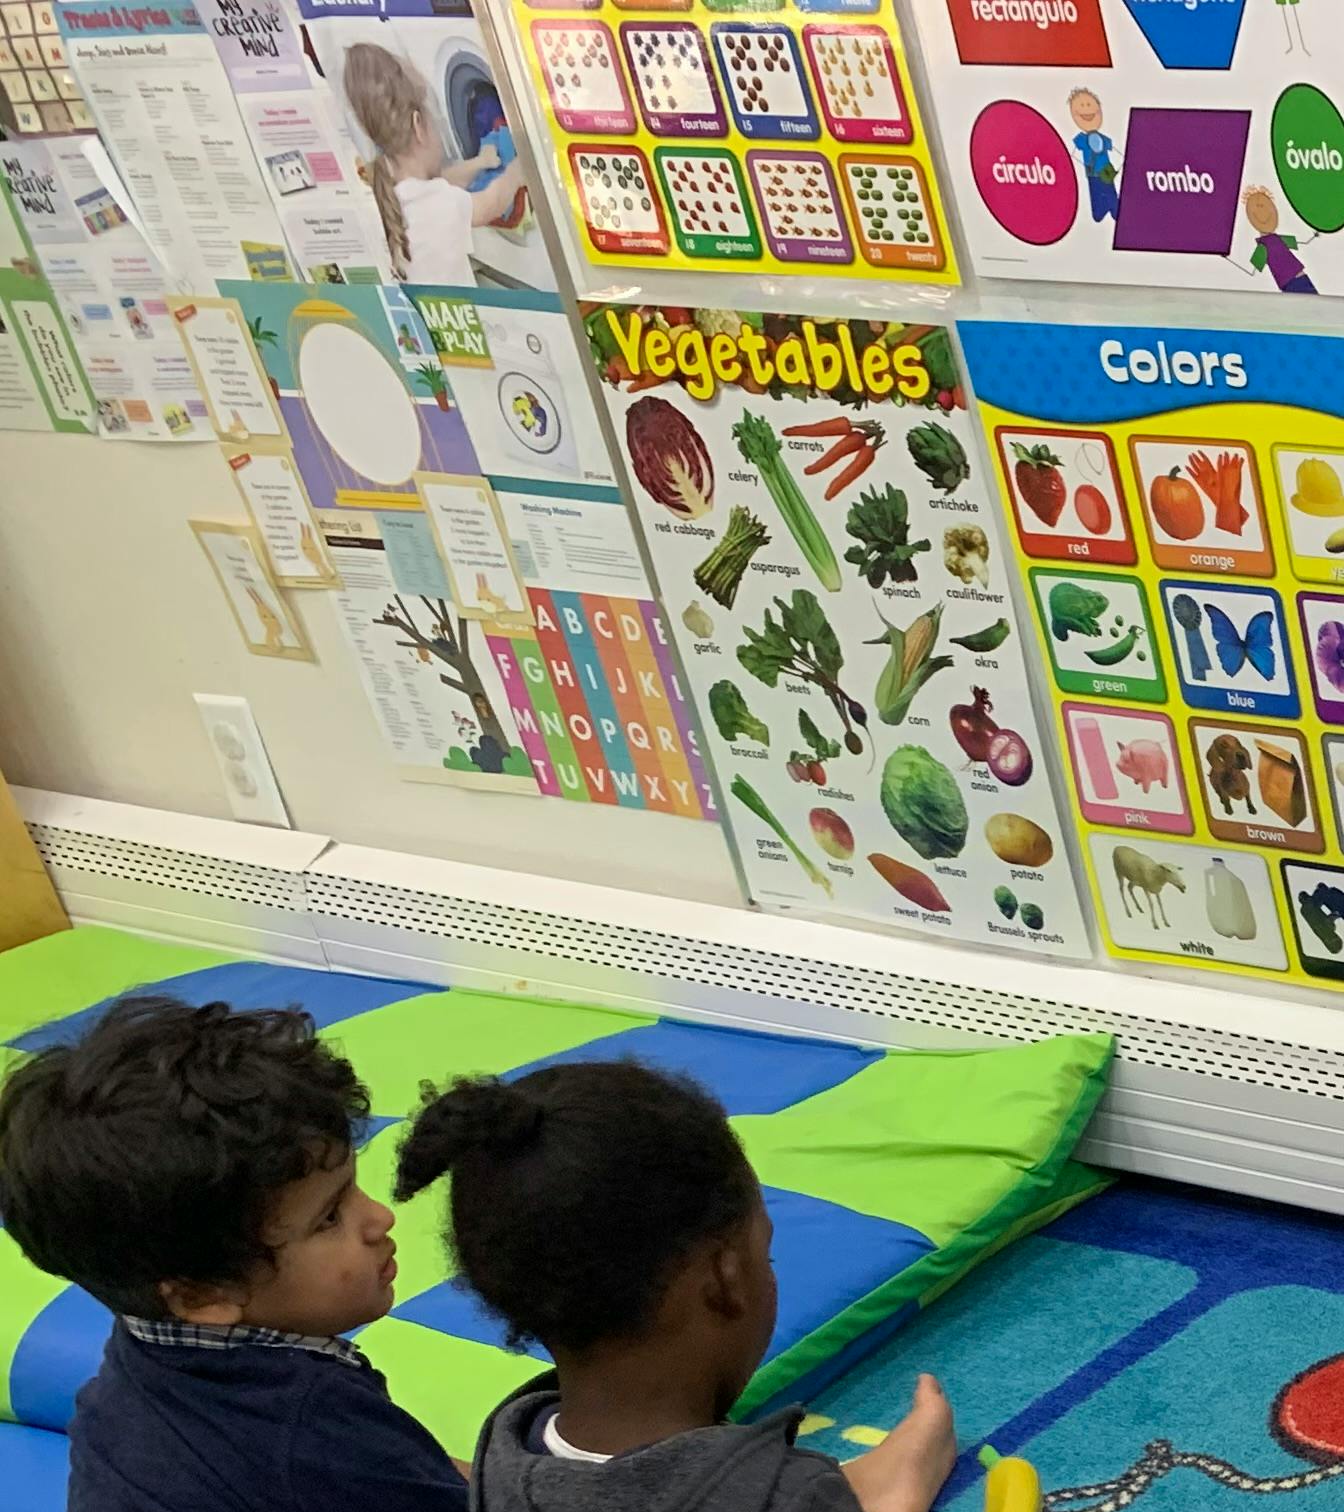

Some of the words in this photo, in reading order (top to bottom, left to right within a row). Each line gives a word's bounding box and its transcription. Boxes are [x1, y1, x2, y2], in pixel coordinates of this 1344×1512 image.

[680, 118, 720, 131] fourteen
[742, 120, 752, 131] 15
[780, 120, 812, 134] fifteen
[872, 124, 905, 137] sixteen
[1286, 140, 1343, 172] óvalo
[1146, 163, 1214, 194] rombo
[685, 238, 695, 250] 18
[715, 241, 754, 254] eighteen
[776, 242, 788, 254] 19
[807, 244, 847, 258] nineteen
[906, 251, 937, 265] twenty
[418, 300, 478, 331] MAKE
[442, 331, 486, 355] PLAY
[605, 308, 931, 401] Vegetables
[1099, 339, 1248, 390] Colors
[787, 439, 825, 453] carrots
[728, 470, 759, 486] celery
[928, 498, 979, 514] artichoke
[654, 521, 673, 534] red
[674, 523, 716, 540] cabbage
[1068, 541, 1090, 555] red
[1190, 552, 1236, 570] orange
[749, 562, 801, 578] asparagus
[882, 584, 922, 601] spinach
[945, 587, 1005, 603] cauliflower
[535, 605, 558, 632] A
[563, 607, 583, 634] B
[594, 611, 613, 639] C
[620, 614, 641, 641] D
[693, 643, 722, 656] garlic
[974, 657, 999, 670] okra
[497, 653, 512, 680] F
[523, 657, 544, 683] G
[551, 660, 575, 687] H
[616, 667, 627, 694] J
[638, 671, 661, 698] K
[785, 681, 811, 696] beets
[1092, 678, 1128, 694] green
[1226, 693, 1255, 709] blue
[908, 714, 931, 727] corn
[512, 707, 539, 734] M
[539, 710, 564, 738] N
[569, 714, 592, 741] O
[600, 718, 616, 743] P
[627, 721, 652, 749] Q
[656, 726, 677, 753] R
[730, 744, 769, 761] broccoli
[972, 768, 990, 780] red
[532, 760, 548, 784] T
[558, 763, 579, 789] U
[586, 767, 604, 793] V
[611, 770, 638, 797] W
[644, 774, 667, 802] X
[672, 779, 689, 805] Y
[970, 780, 999, 793] onion
[817, 786, 855, 802] radishes
[1124, 810, 1151, 825] pink
[1246, 826, 1287, 843] brown
[755, 838, 784, 851] green
[758, 849, 788, 862] onions
[826, 861, 854, 877] turnip
[934, 863, 968, 878] lettuce
[1010, 869, 1045, 882] potato
[894, 906, 919, 919] sweet
[921, 910, 952, 925] potato
[987, 922, 1025, 939] Brussels
[1027, 928, 1065, 944] sprouts
[1180, 940, 1214, 957] white
